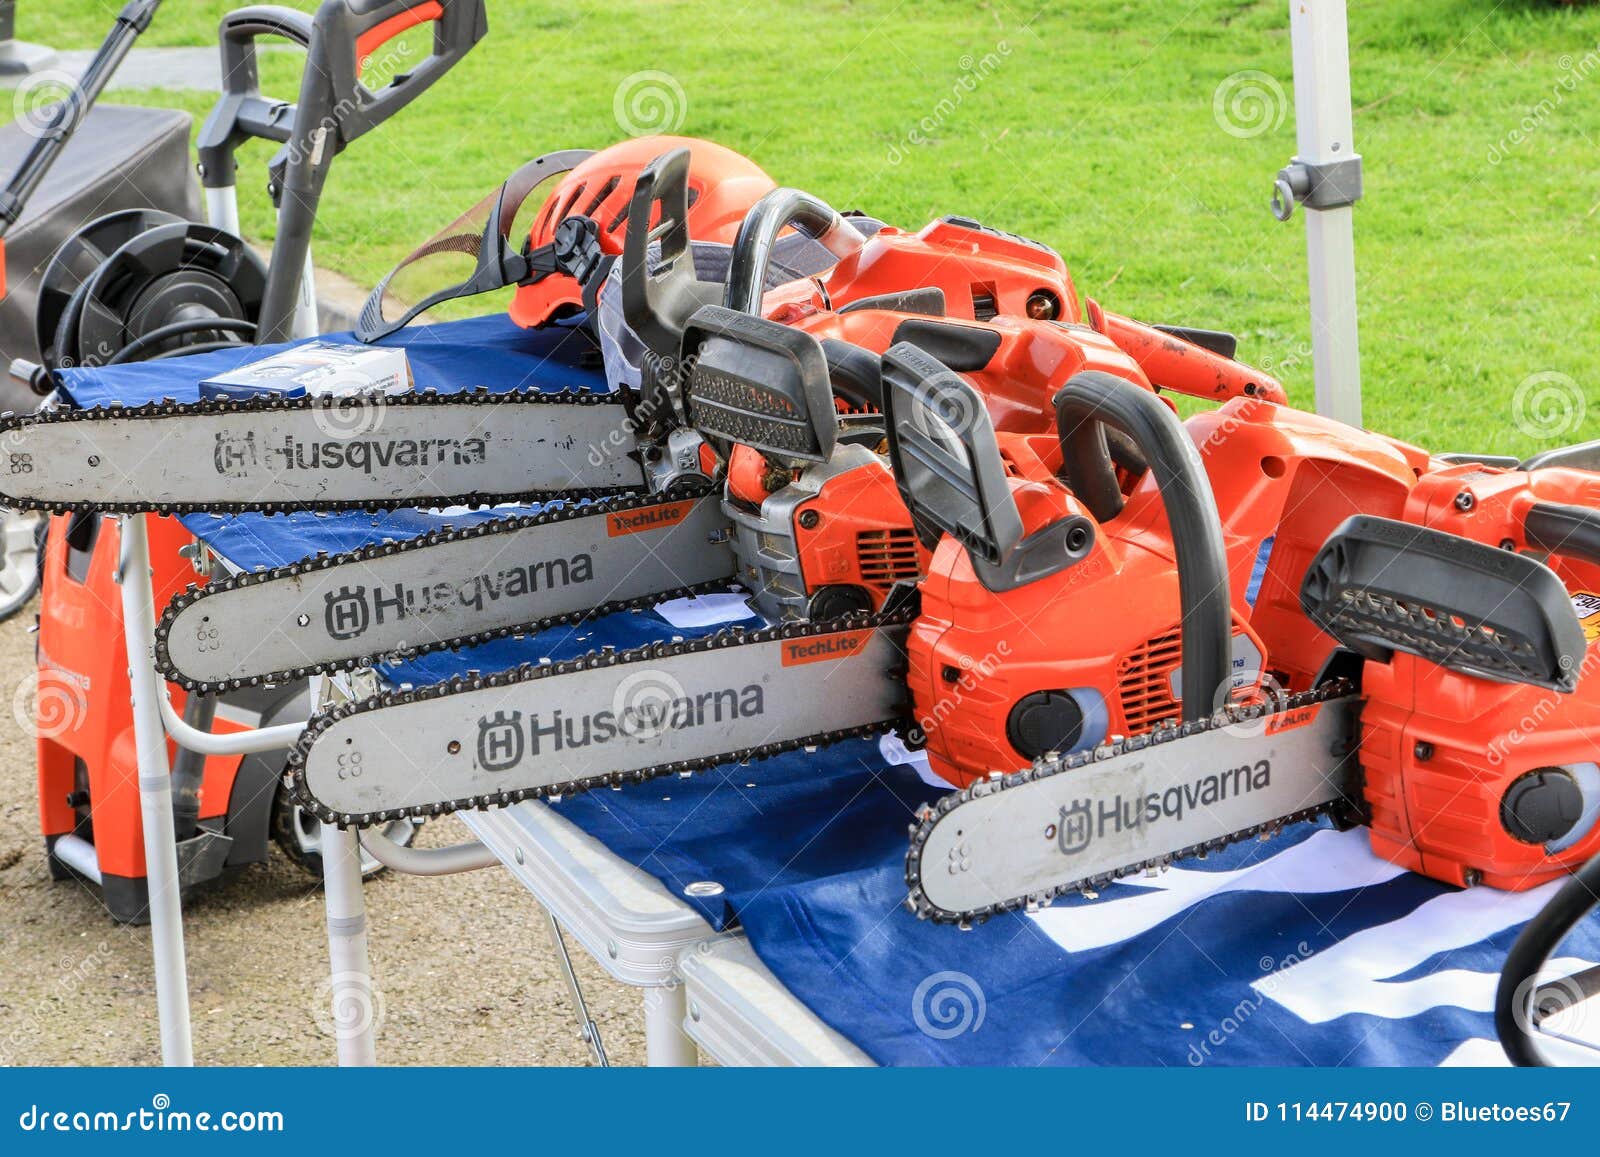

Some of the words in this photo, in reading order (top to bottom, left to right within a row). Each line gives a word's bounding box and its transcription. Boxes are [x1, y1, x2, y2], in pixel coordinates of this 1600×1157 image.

[264, 435, 486, 475] Husqvarna
[614, 506, 681, 532] TechLite
[373, 552, 594, 626] Husqvarna
[788, 635, 859, 660] TechLite
[530, 683, 766, 757] Husqvarna
[1097, 758, 1271, 838] Husqvarna
